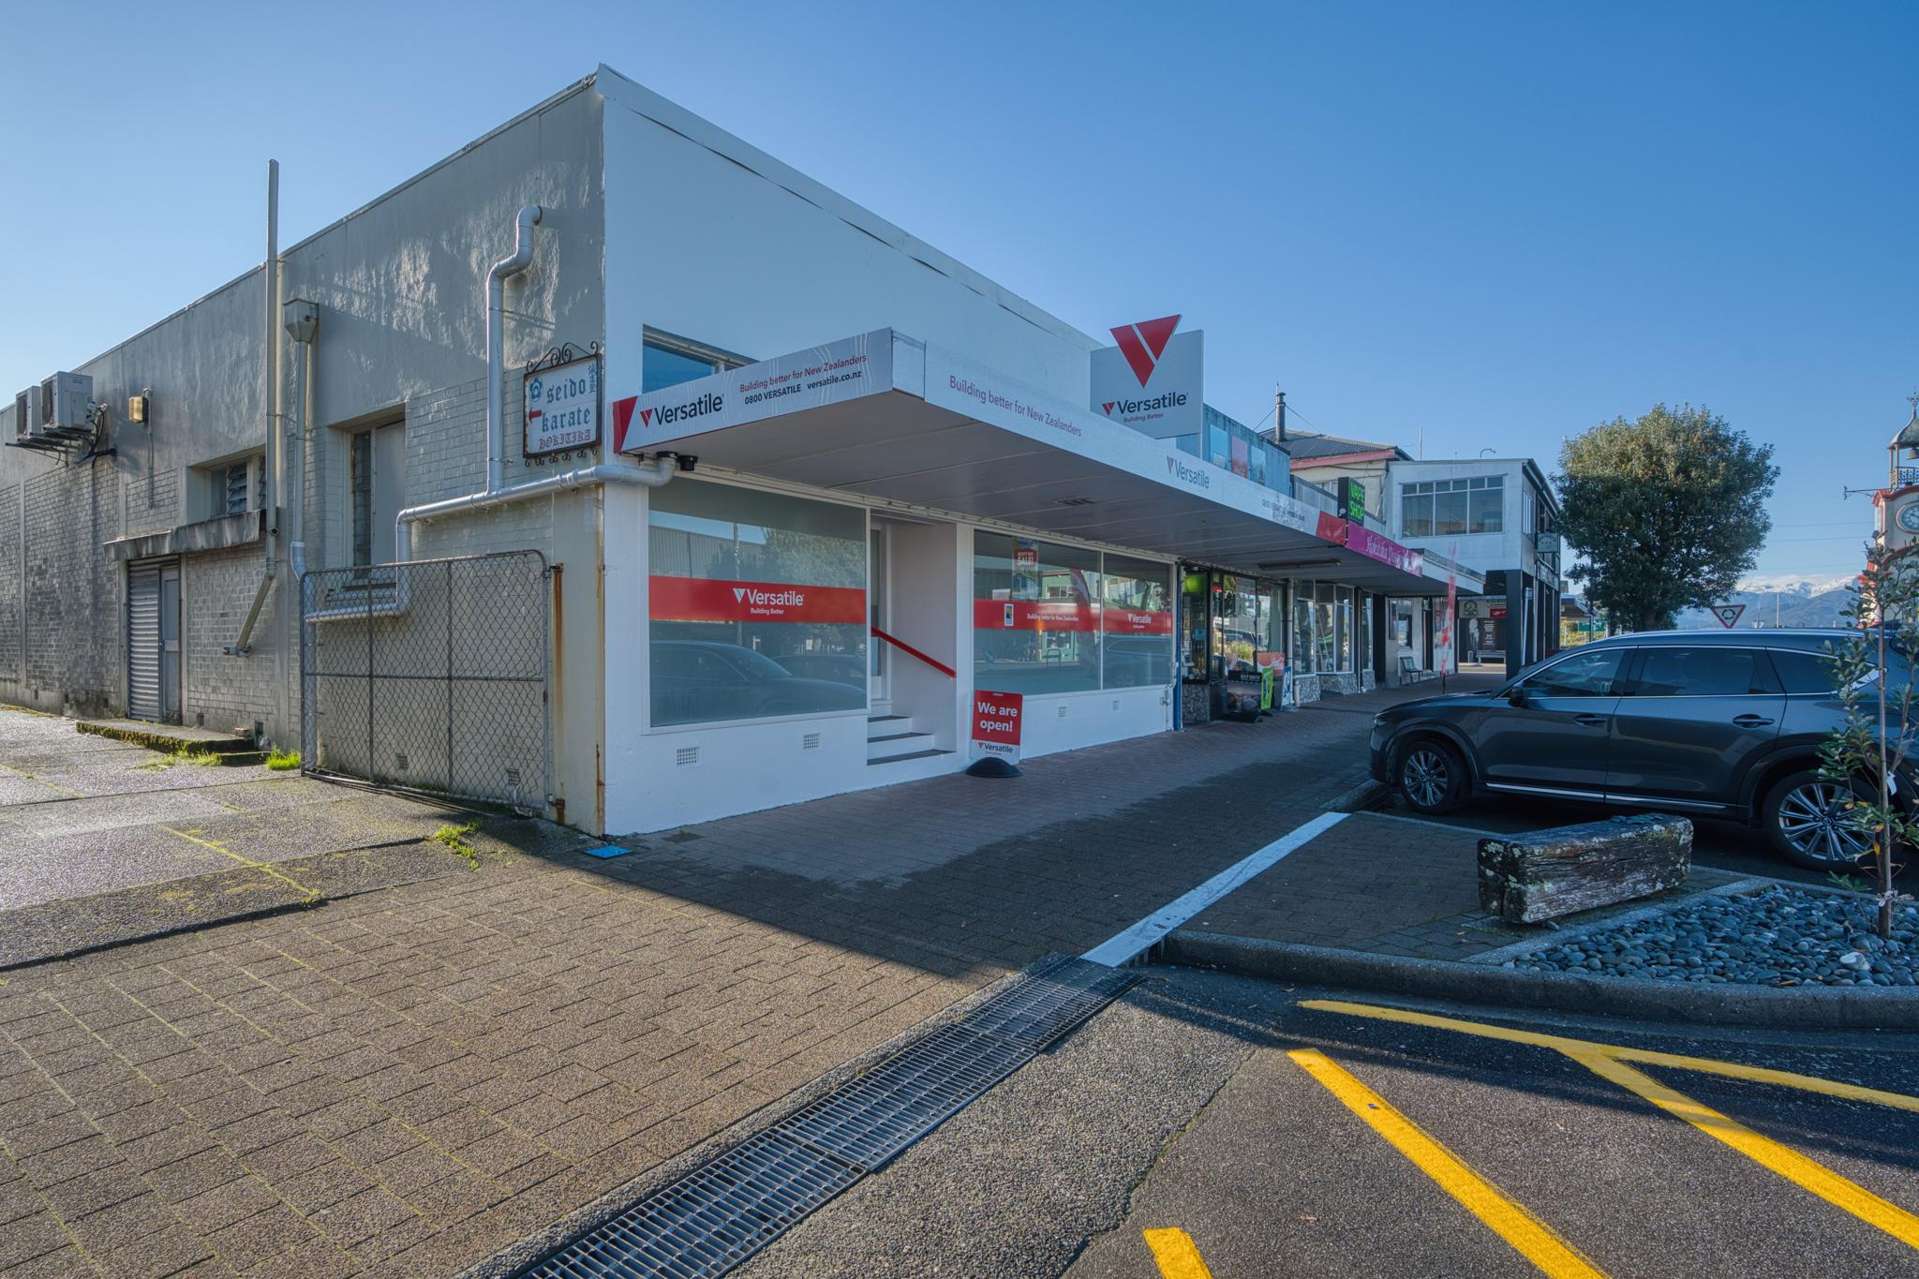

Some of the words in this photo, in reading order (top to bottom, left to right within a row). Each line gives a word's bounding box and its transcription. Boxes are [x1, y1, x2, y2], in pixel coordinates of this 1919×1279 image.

[740, 380, 768, 393] Building
[769, 373, 791, 386] better
[792, 370, 803, 379] for
[804, 367, 823, 377] New
[823, 355, 867, 372] Zealanders
[546, 378, 586, 403] seido
[744, 392, 763, 405] 0800
[763, 384, 801, 400] VERSATILE
[807, 371, 863, 390] versatile.co.nz
[654, 393, 723, 425] Versatile
[949, 375, 987, 404] Building
[988, 390, 1013, 410] better
[1014, 400, 1025, 415] for
[1027, 406, 1045, 421] New
[1045, 412, 1083, 437] Zealanders
[1117, 392, 1188, 414] Versatile
[541, 407, 591, 432] karate
[1174, 462, 1210, 489] Versatile
[747, 589, 803, 606] Versatile
[977, 702, 996, 715] We
[998, 706, 1018, 717] are
[980, 720, 1013, 733] open!
